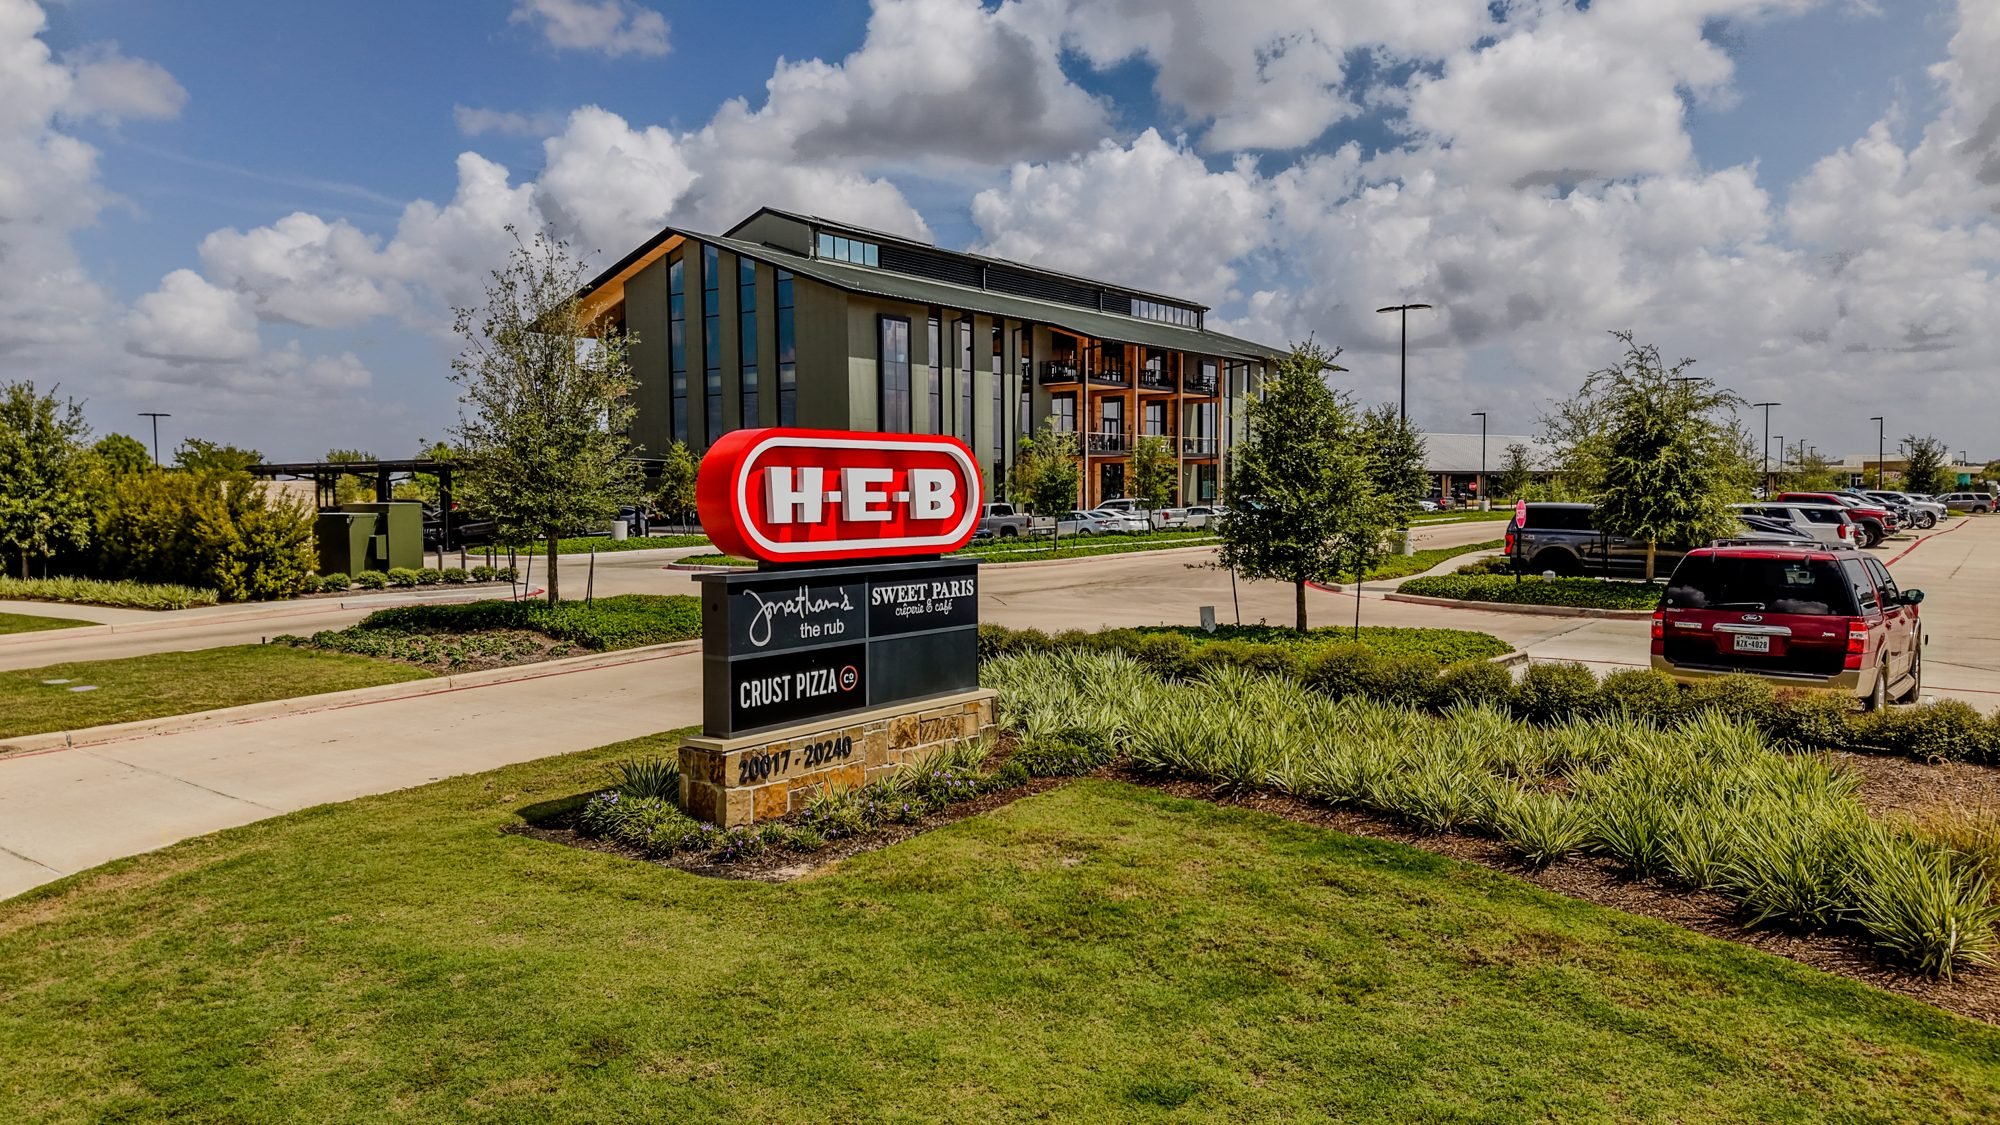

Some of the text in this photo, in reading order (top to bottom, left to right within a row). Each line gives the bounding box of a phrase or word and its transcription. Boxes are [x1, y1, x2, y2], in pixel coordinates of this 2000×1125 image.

[764, 466, 957, 524] H-E-B
[872, 579, 975, 606] SWEET PARIS
[895, 598, 953, 618] crêperie & café
[743, 584, 854, 647] Jonathan's
[799, 618, 845, 639] the rub
[740, 675, 792, 709] CRUST
[796, 668, 838, 699] PIZZA
[739, 749, 791, 785] 20017
[803, 735, 853, 769] 20240
